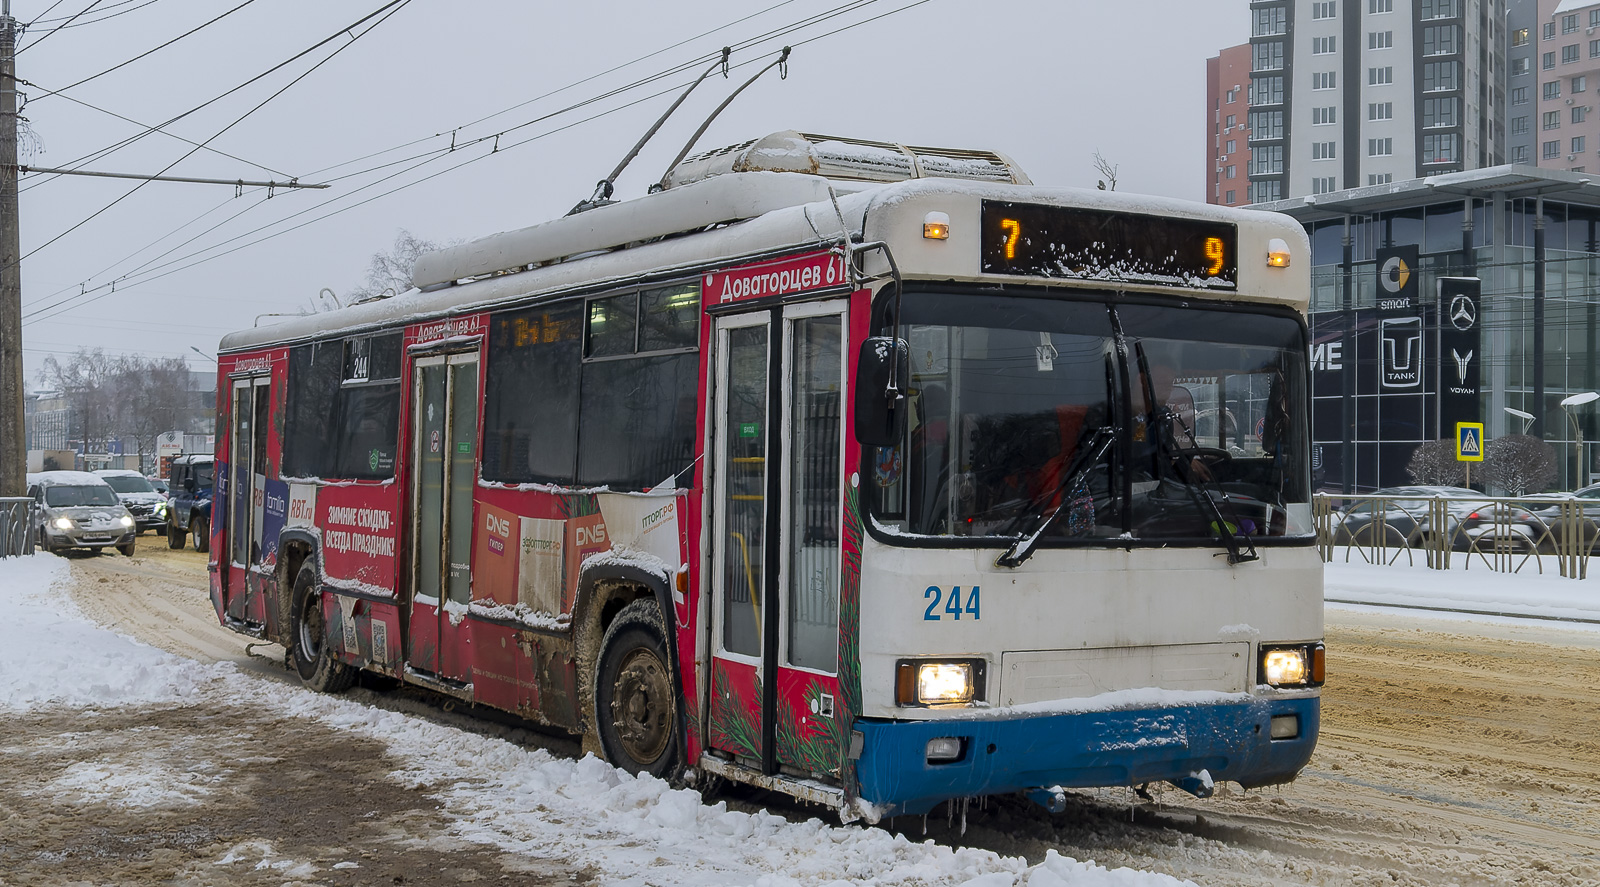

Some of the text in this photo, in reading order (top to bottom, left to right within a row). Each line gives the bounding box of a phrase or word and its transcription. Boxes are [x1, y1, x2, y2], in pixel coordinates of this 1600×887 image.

[1001, 218, 1020, 259] 7
[1205, 237, 1224, 275] 9
[720, 256, 844, 304] Доваторцев 61
[1380, 297, 1411, 311] smart
[353, 357, 368, 379] 244
[1387, 372, 1416, 380] TANK
[1450, 387, 1475, 395] VOYAH
[291, 499, 313, 520] RBT.ru
[328, 506, 357, 526] ЗИМНИЕ
[357, 508, 390, 533] СКИДКИ
[486, 513, 510, 538] DNS
[576, 523, 605, 547] DNS
[325, 530, 351, 554] ВСЕГДА
[489, 539, 504, 552] ГИПЕР
[923, 585, 981, 621] 244
